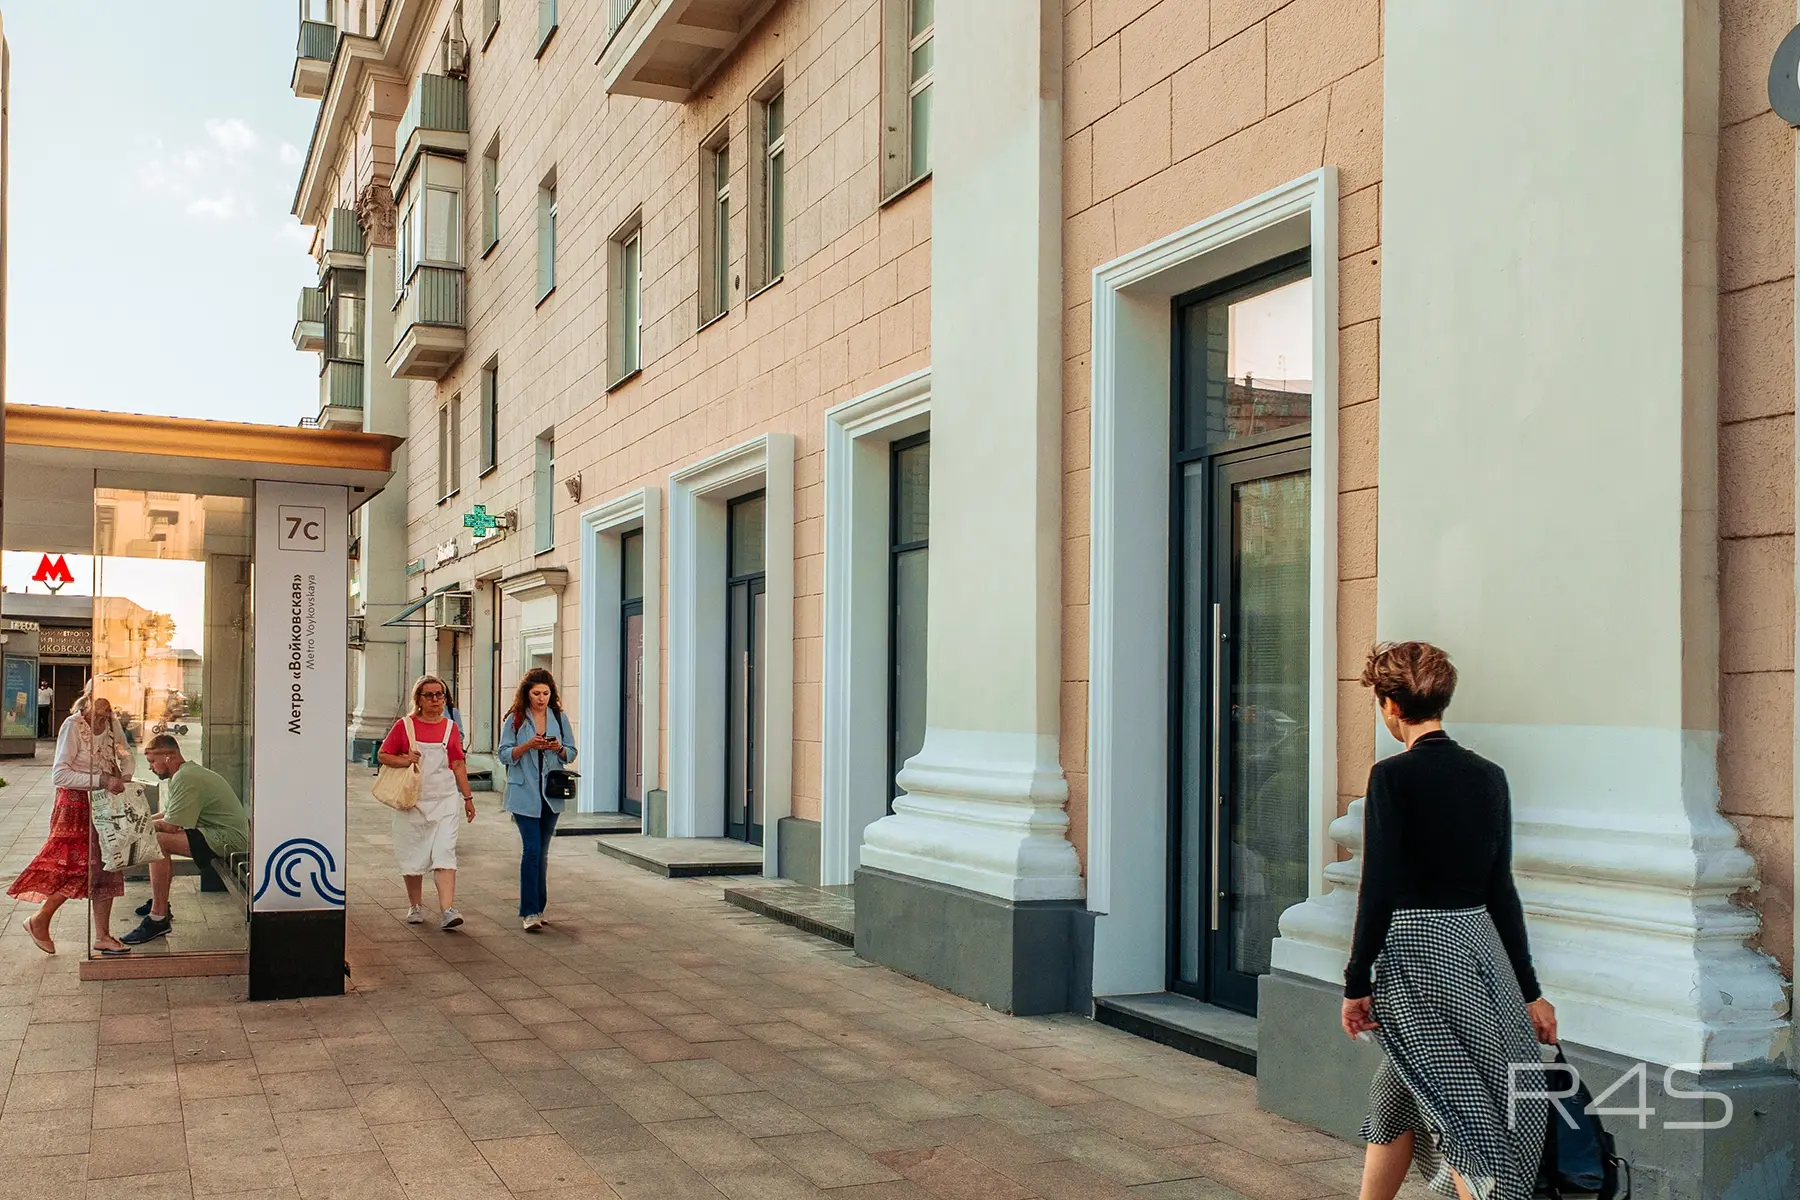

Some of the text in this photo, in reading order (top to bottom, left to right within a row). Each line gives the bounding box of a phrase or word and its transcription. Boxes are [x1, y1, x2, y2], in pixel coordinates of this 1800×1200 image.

[10, 621, 40, 632] ПРЕССА
[288, 573, 304, 735] Метро «Войковская»
[306, 574, 317, 670] Metro Voykovskaya
